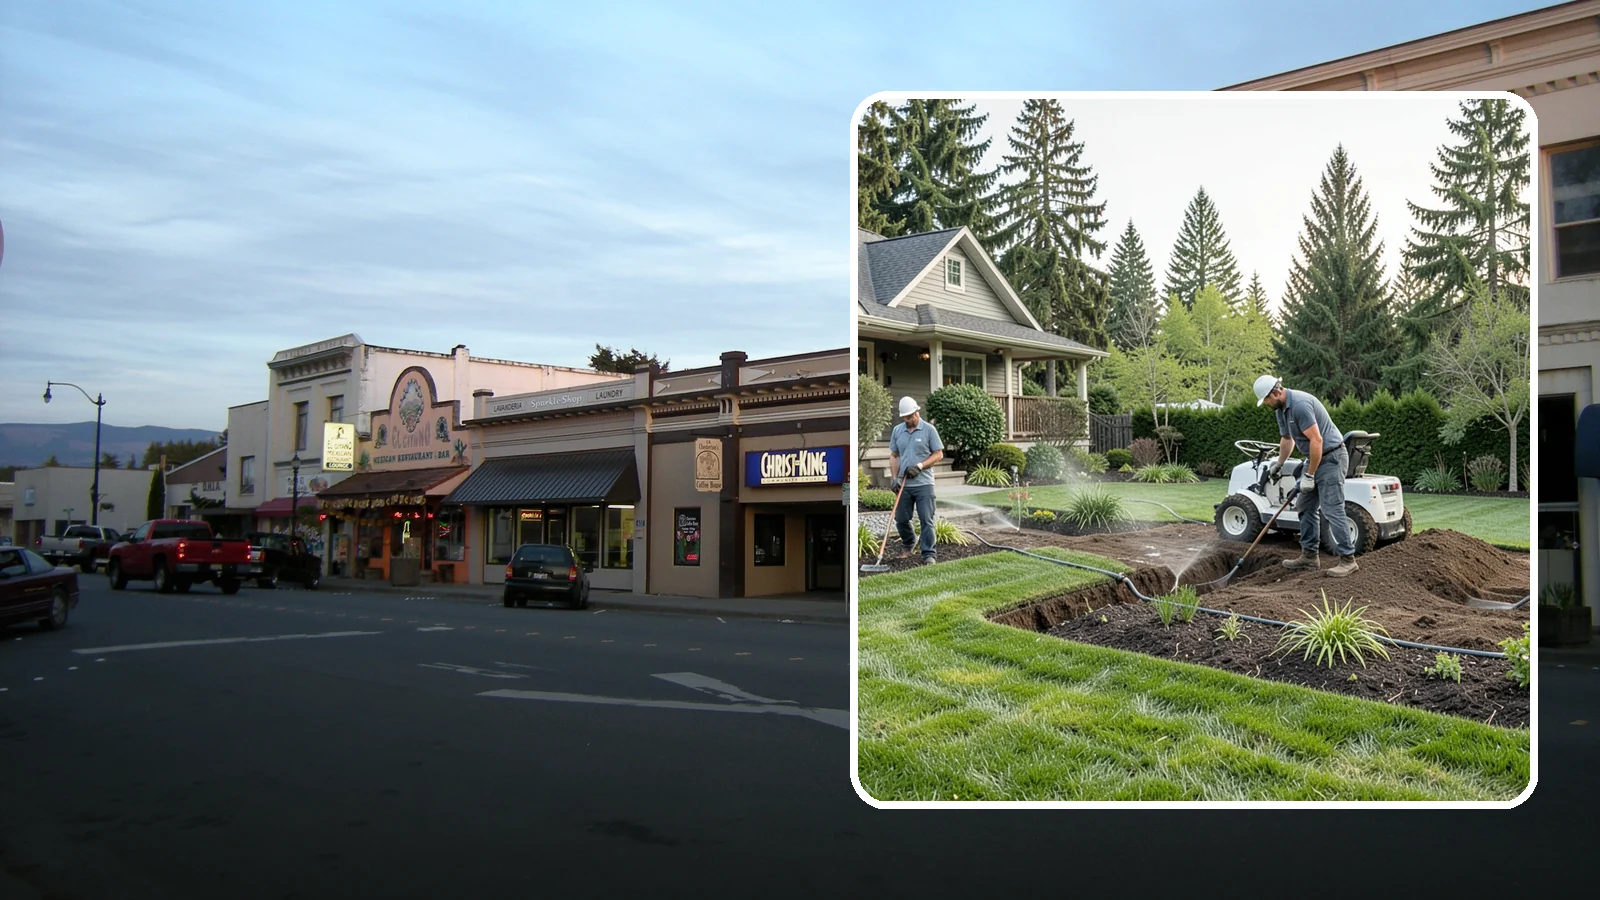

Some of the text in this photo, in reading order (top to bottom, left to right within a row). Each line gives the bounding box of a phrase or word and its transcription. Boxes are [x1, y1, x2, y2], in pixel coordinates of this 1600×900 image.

[493, 389, 623, 412] LAVANDERIA Sparkle Shop LAUNDRY
[391, 425, 401, 450] EL
[373, 455, 396, 464] MEXICAN
[397, 452, 433, 462] RESTAURANT
[438, 450, 450, 459] BAR
[761, 450, 827, 478] CHRIST KING
